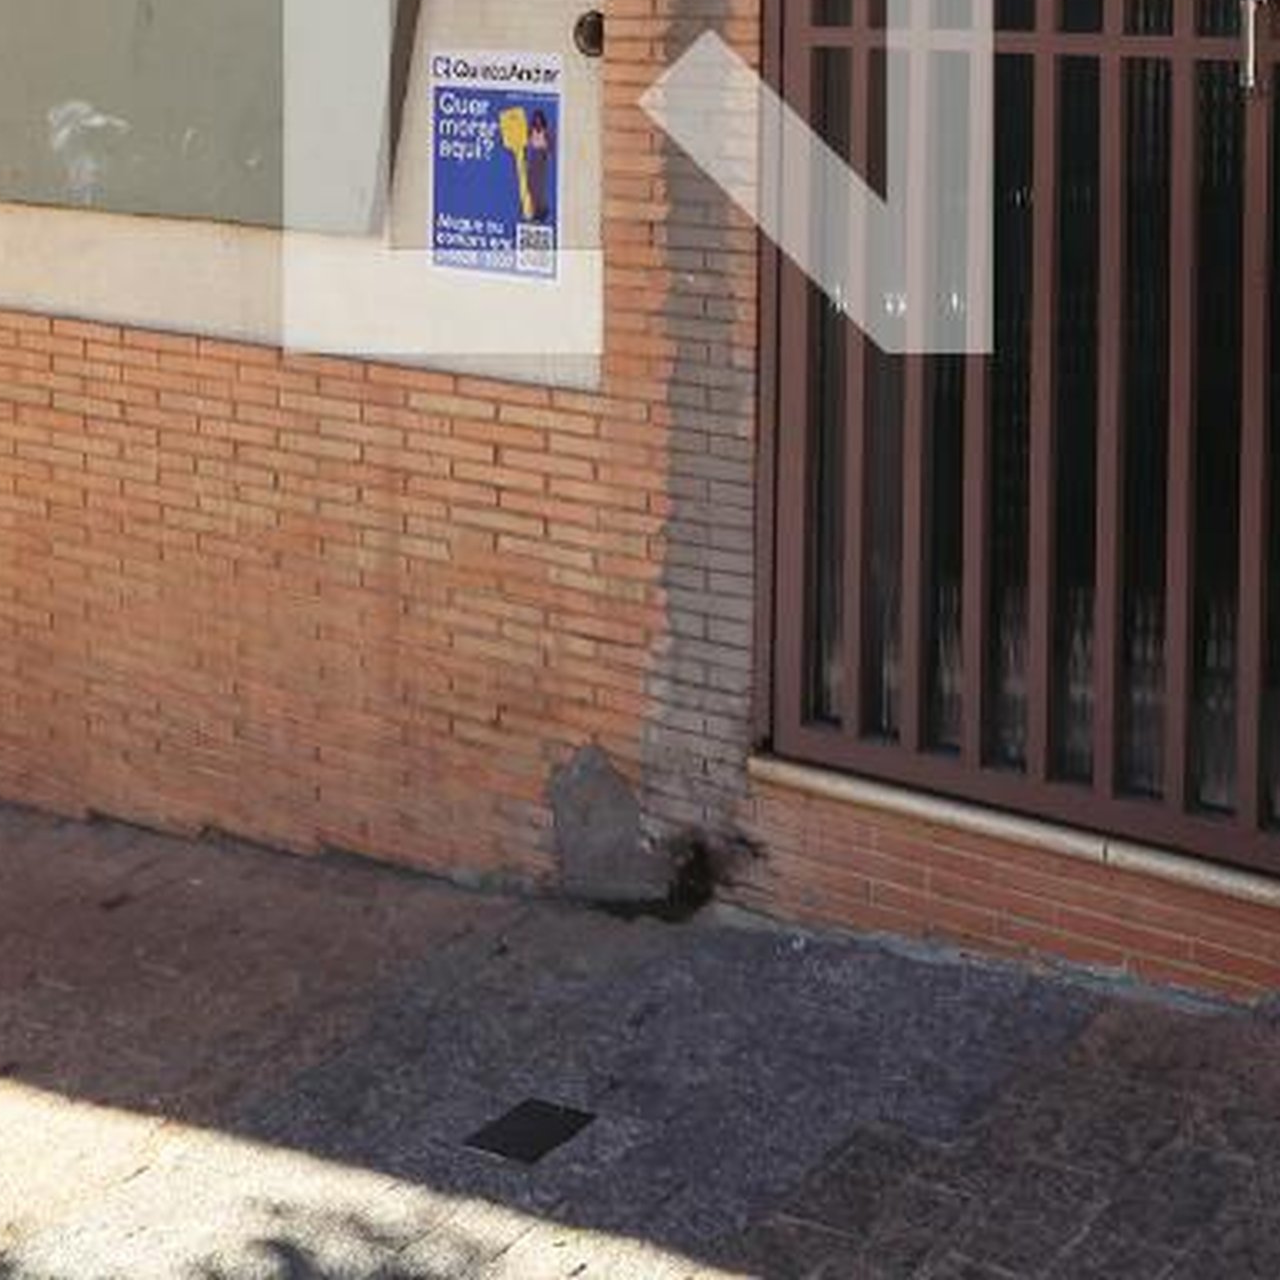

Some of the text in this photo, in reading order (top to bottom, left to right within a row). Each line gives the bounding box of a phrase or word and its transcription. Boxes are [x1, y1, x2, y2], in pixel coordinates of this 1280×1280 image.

[439, 92, 491, 116] Quer
[439, 119, 497, 138] morar
[439, 136, 495, 164] aqui?
